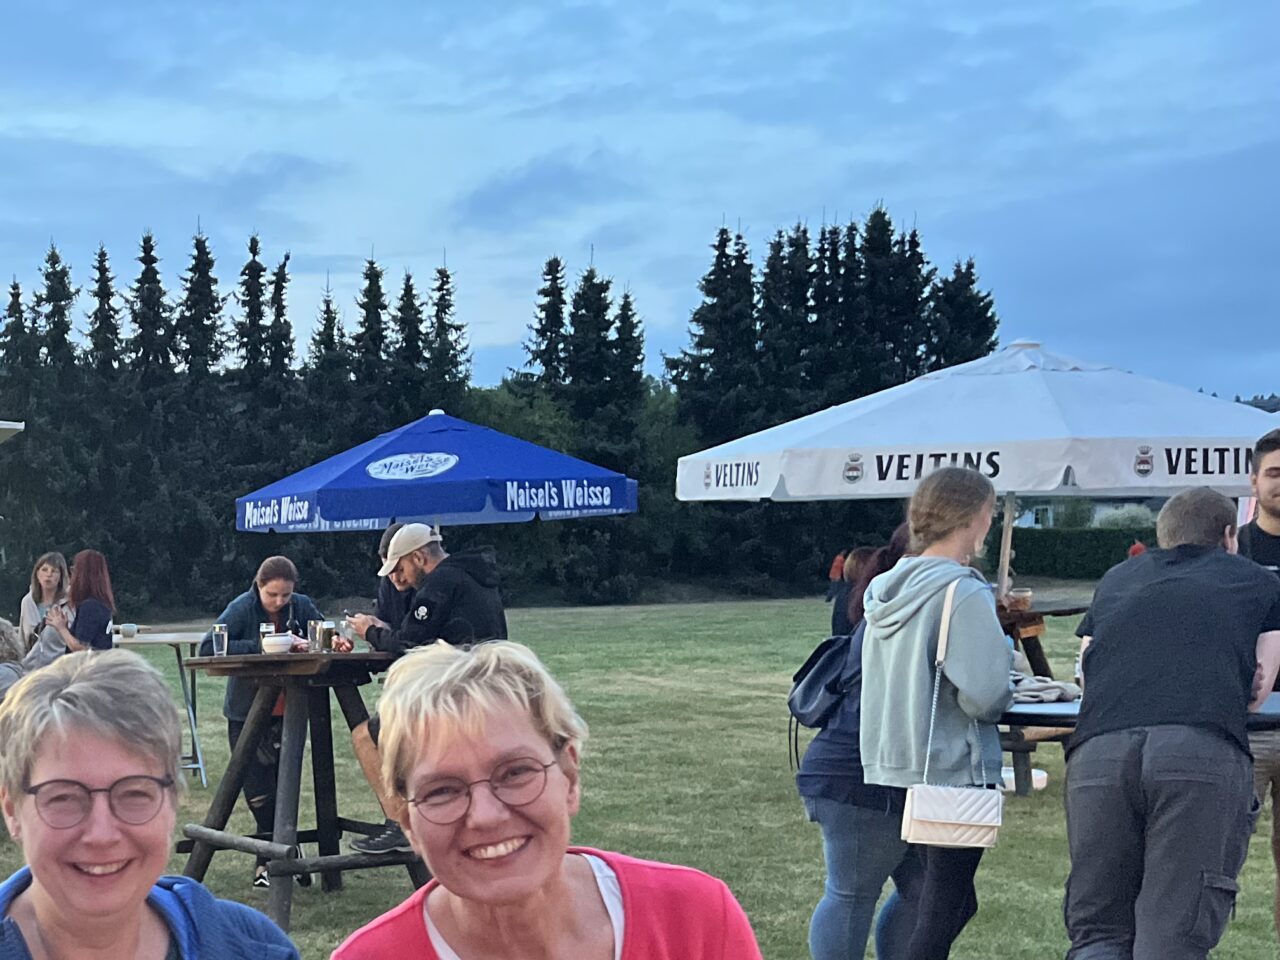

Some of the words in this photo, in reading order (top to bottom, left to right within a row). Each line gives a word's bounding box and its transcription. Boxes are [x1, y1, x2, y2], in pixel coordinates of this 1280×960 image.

[716, 461, 760, 487] VELTINS
[506, 481, 558, 511] Maisel's
[561, 479, 611, 508] Weisse
[245, 500, 278, 529] Maisel's
[281, 496, 309, 525] Weisse
